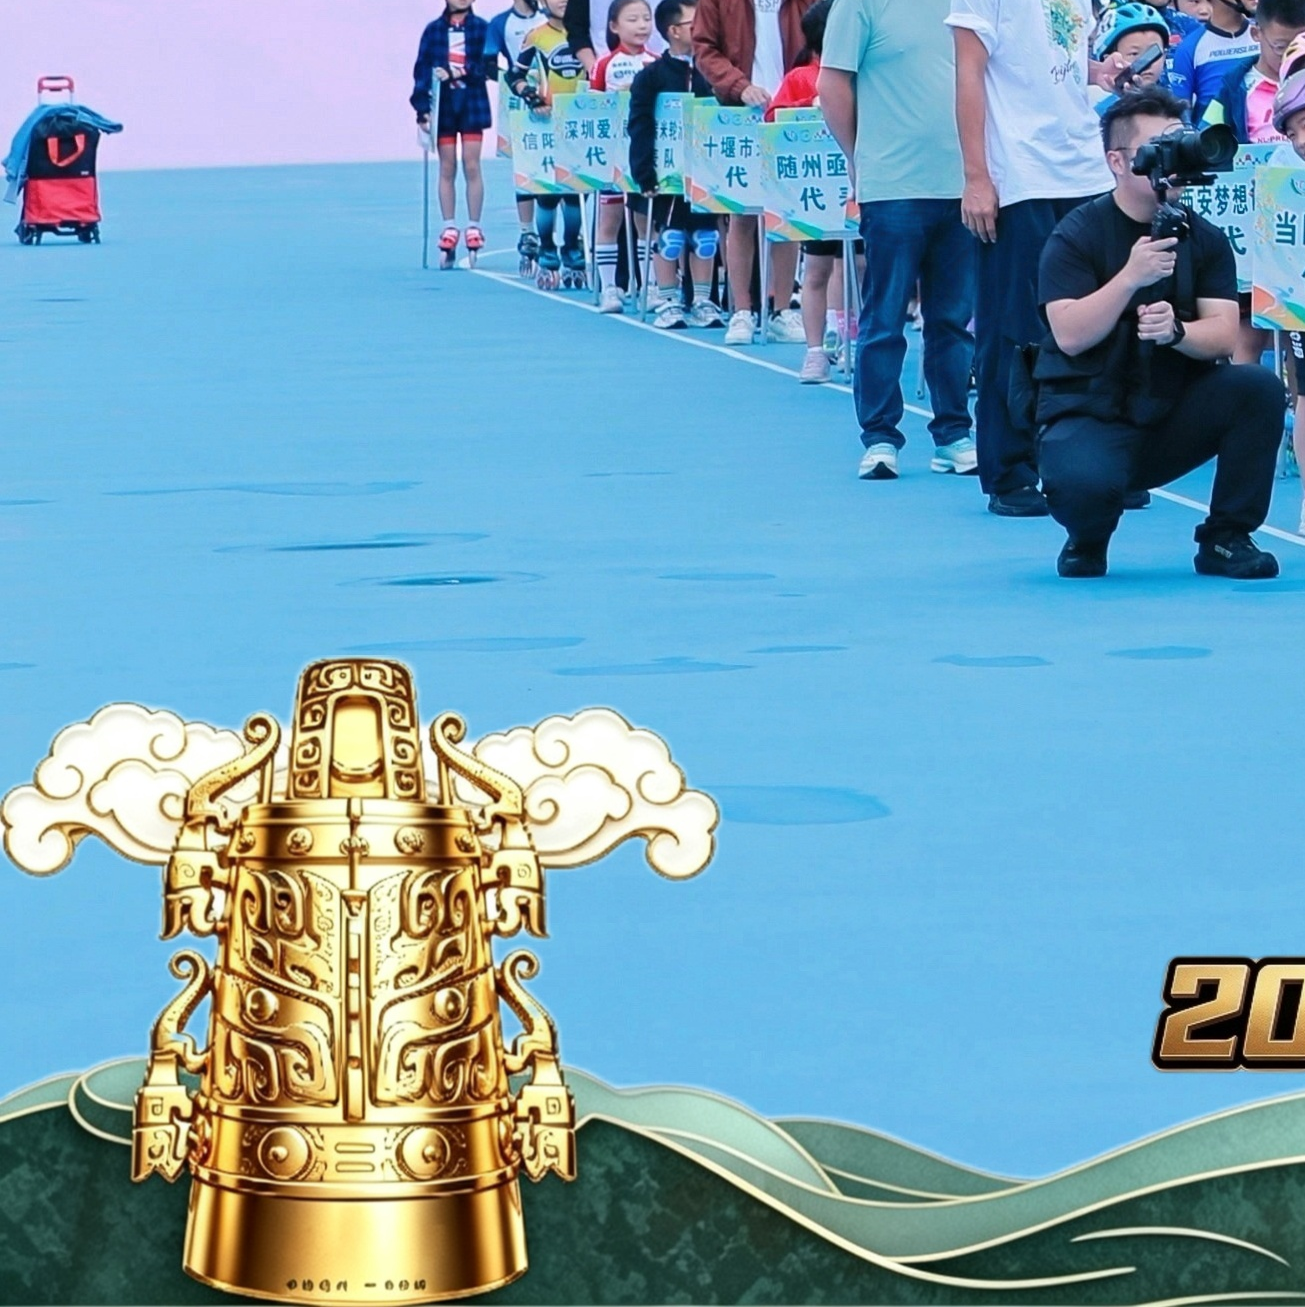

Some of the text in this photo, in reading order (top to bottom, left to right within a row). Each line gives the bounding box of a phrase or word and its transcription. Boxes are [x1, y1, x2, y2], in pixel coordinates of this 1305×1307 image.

[565, 119, 616, 140] 深圳爱
[585, 146, 607, 166] 代
[703, 136, 761, 159] 十堰市
[726, 166, 748, 188] 代
[1179, 180, 1256, 217] 西安梦想
